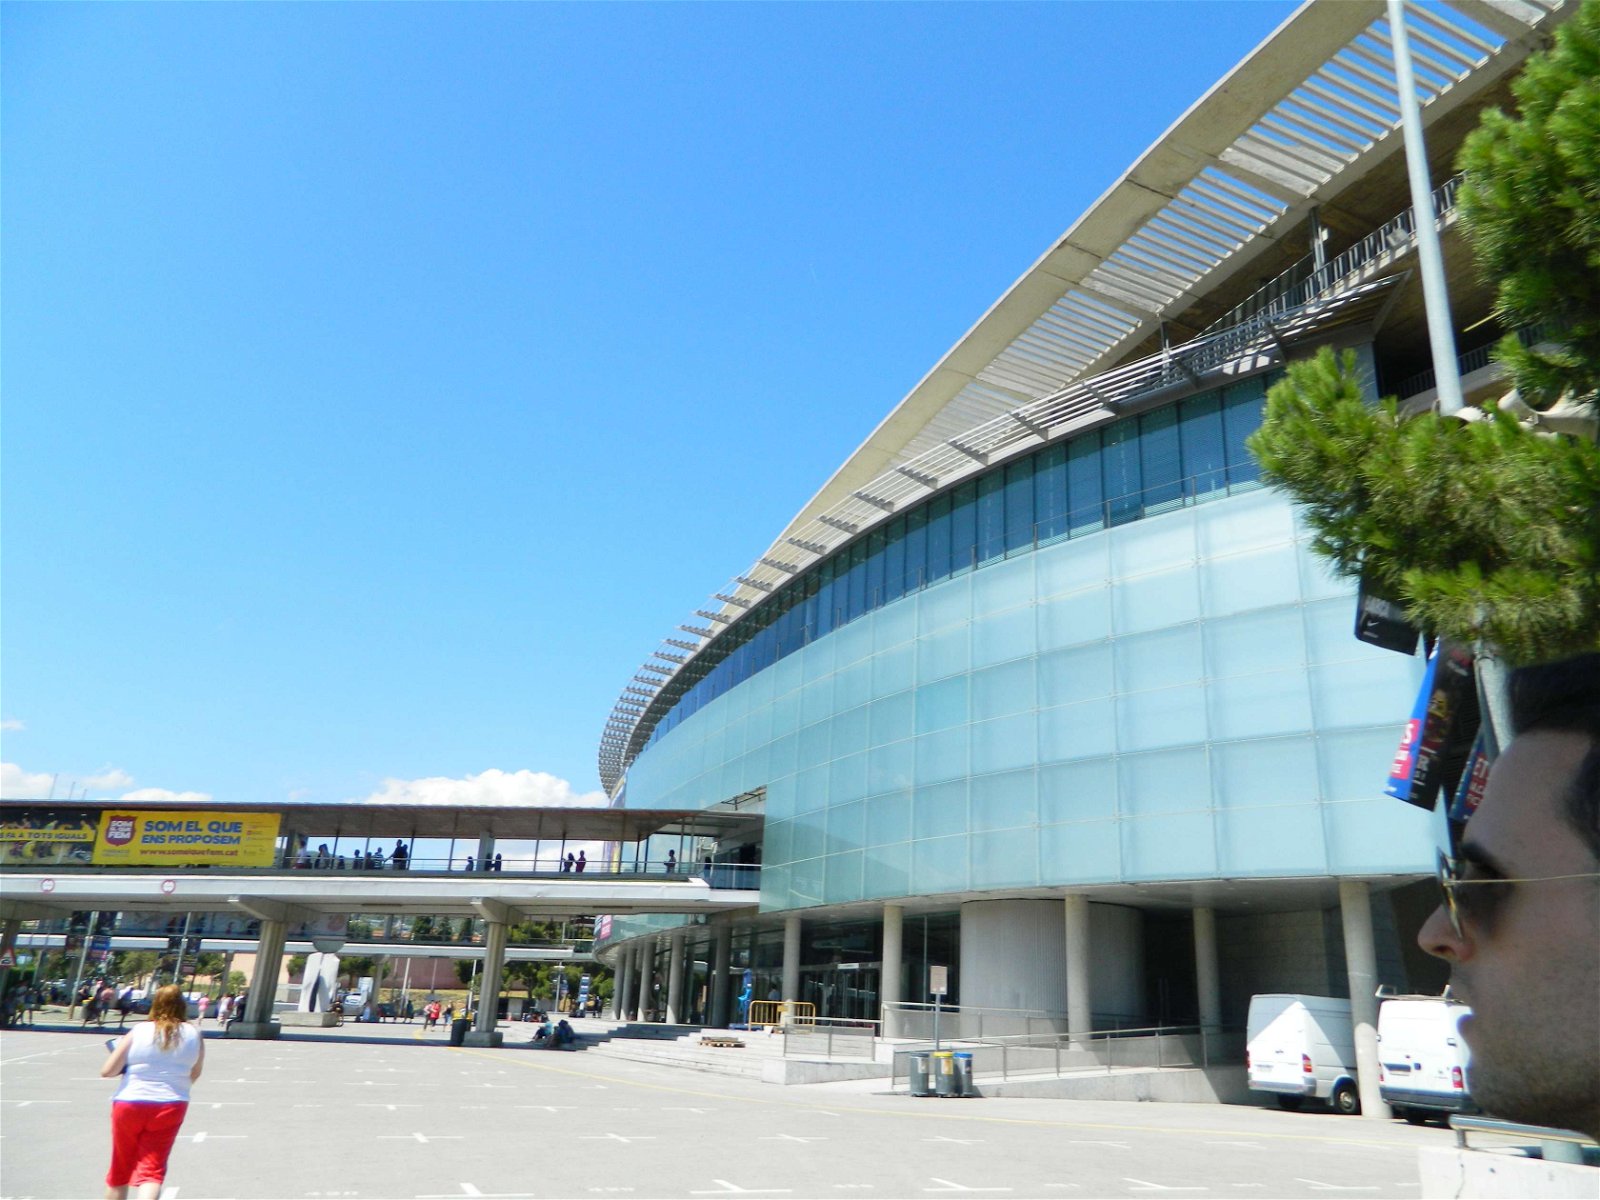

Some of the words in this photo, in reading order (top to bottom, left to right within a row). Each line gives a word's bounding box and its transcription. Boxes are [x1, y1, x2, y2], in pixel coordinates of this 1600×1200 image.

[144, 820, 183, 832] SOM
[185, 821, 202, 832] EL
[207, 821, 243, 834] QUE
[107, 831, 132, 839] FEM
[141, 834, 166, 844] ENS
[168, 834, 241, 845] PROPOSEM
